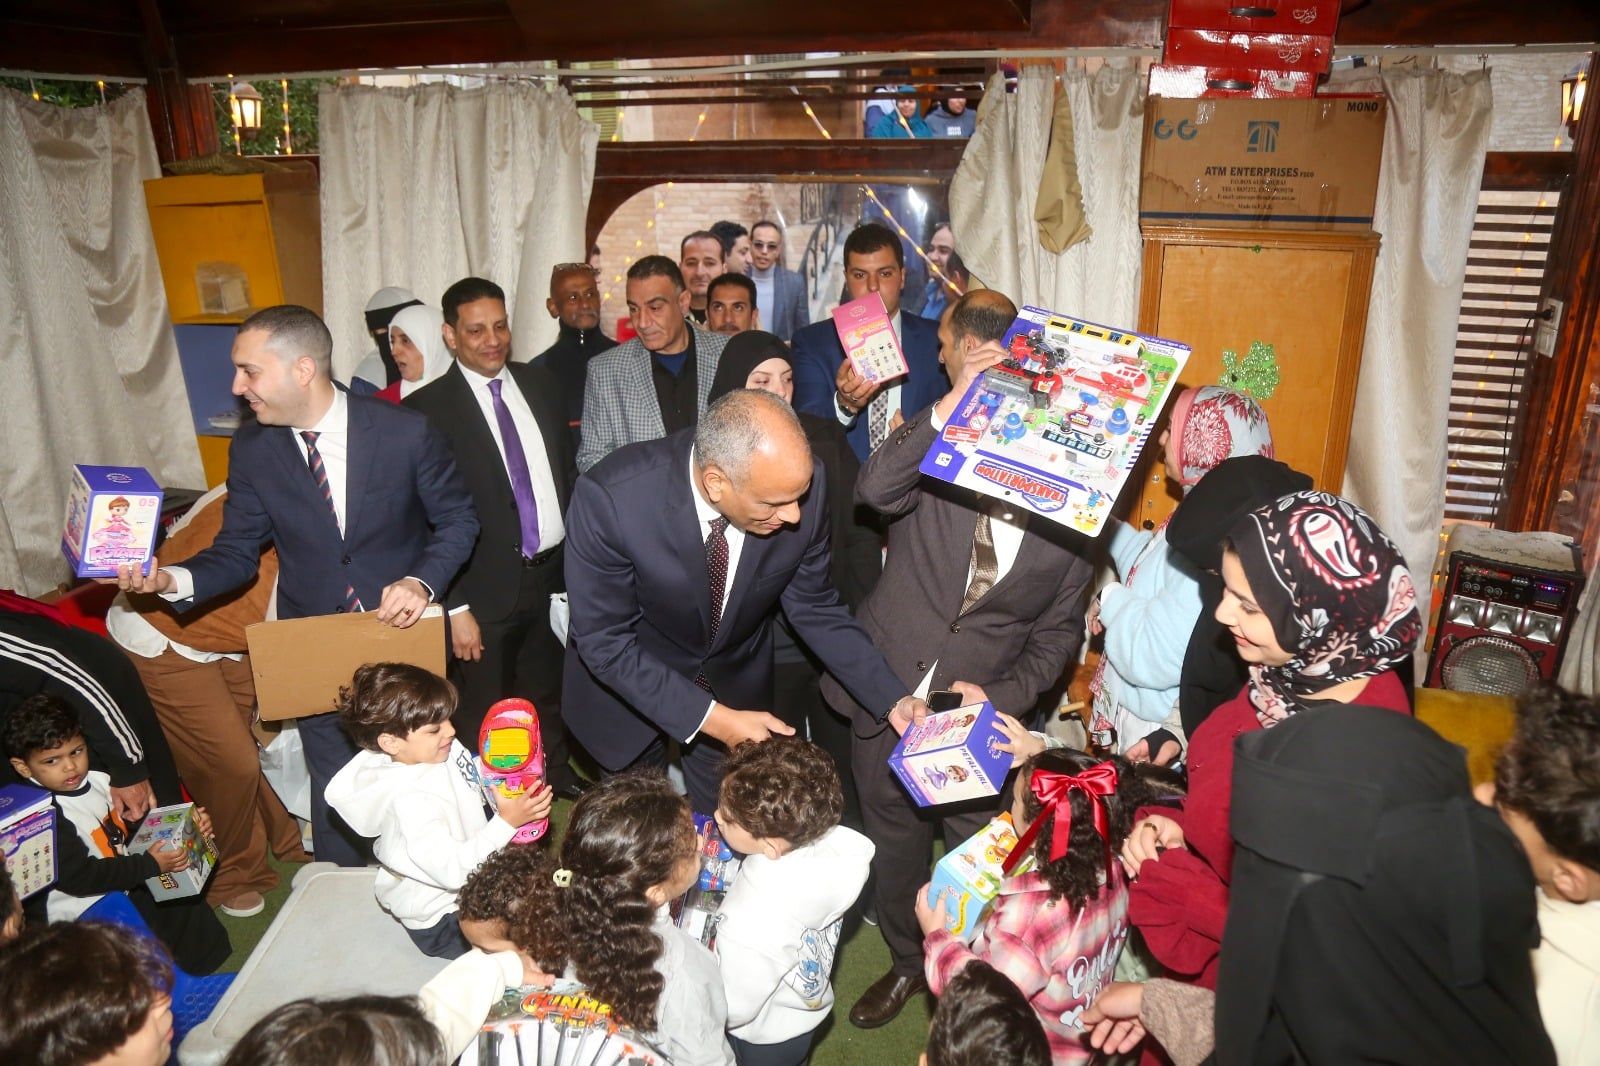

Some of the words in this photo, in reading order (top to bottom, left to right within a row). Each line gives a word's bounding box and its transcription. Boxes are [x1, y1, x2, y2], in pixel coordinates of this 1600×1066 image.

[1347, 101, 1378, 113] MONO
[1204, 166, 1227, 176] ATM
[1230, 167, 1299, 177] ENTERPRISES
[976, 464, 1065, 502] TRANSPORTATION
[960, 747, 977, 769] PETAL
[974, 768, 988, 785] GIRL
